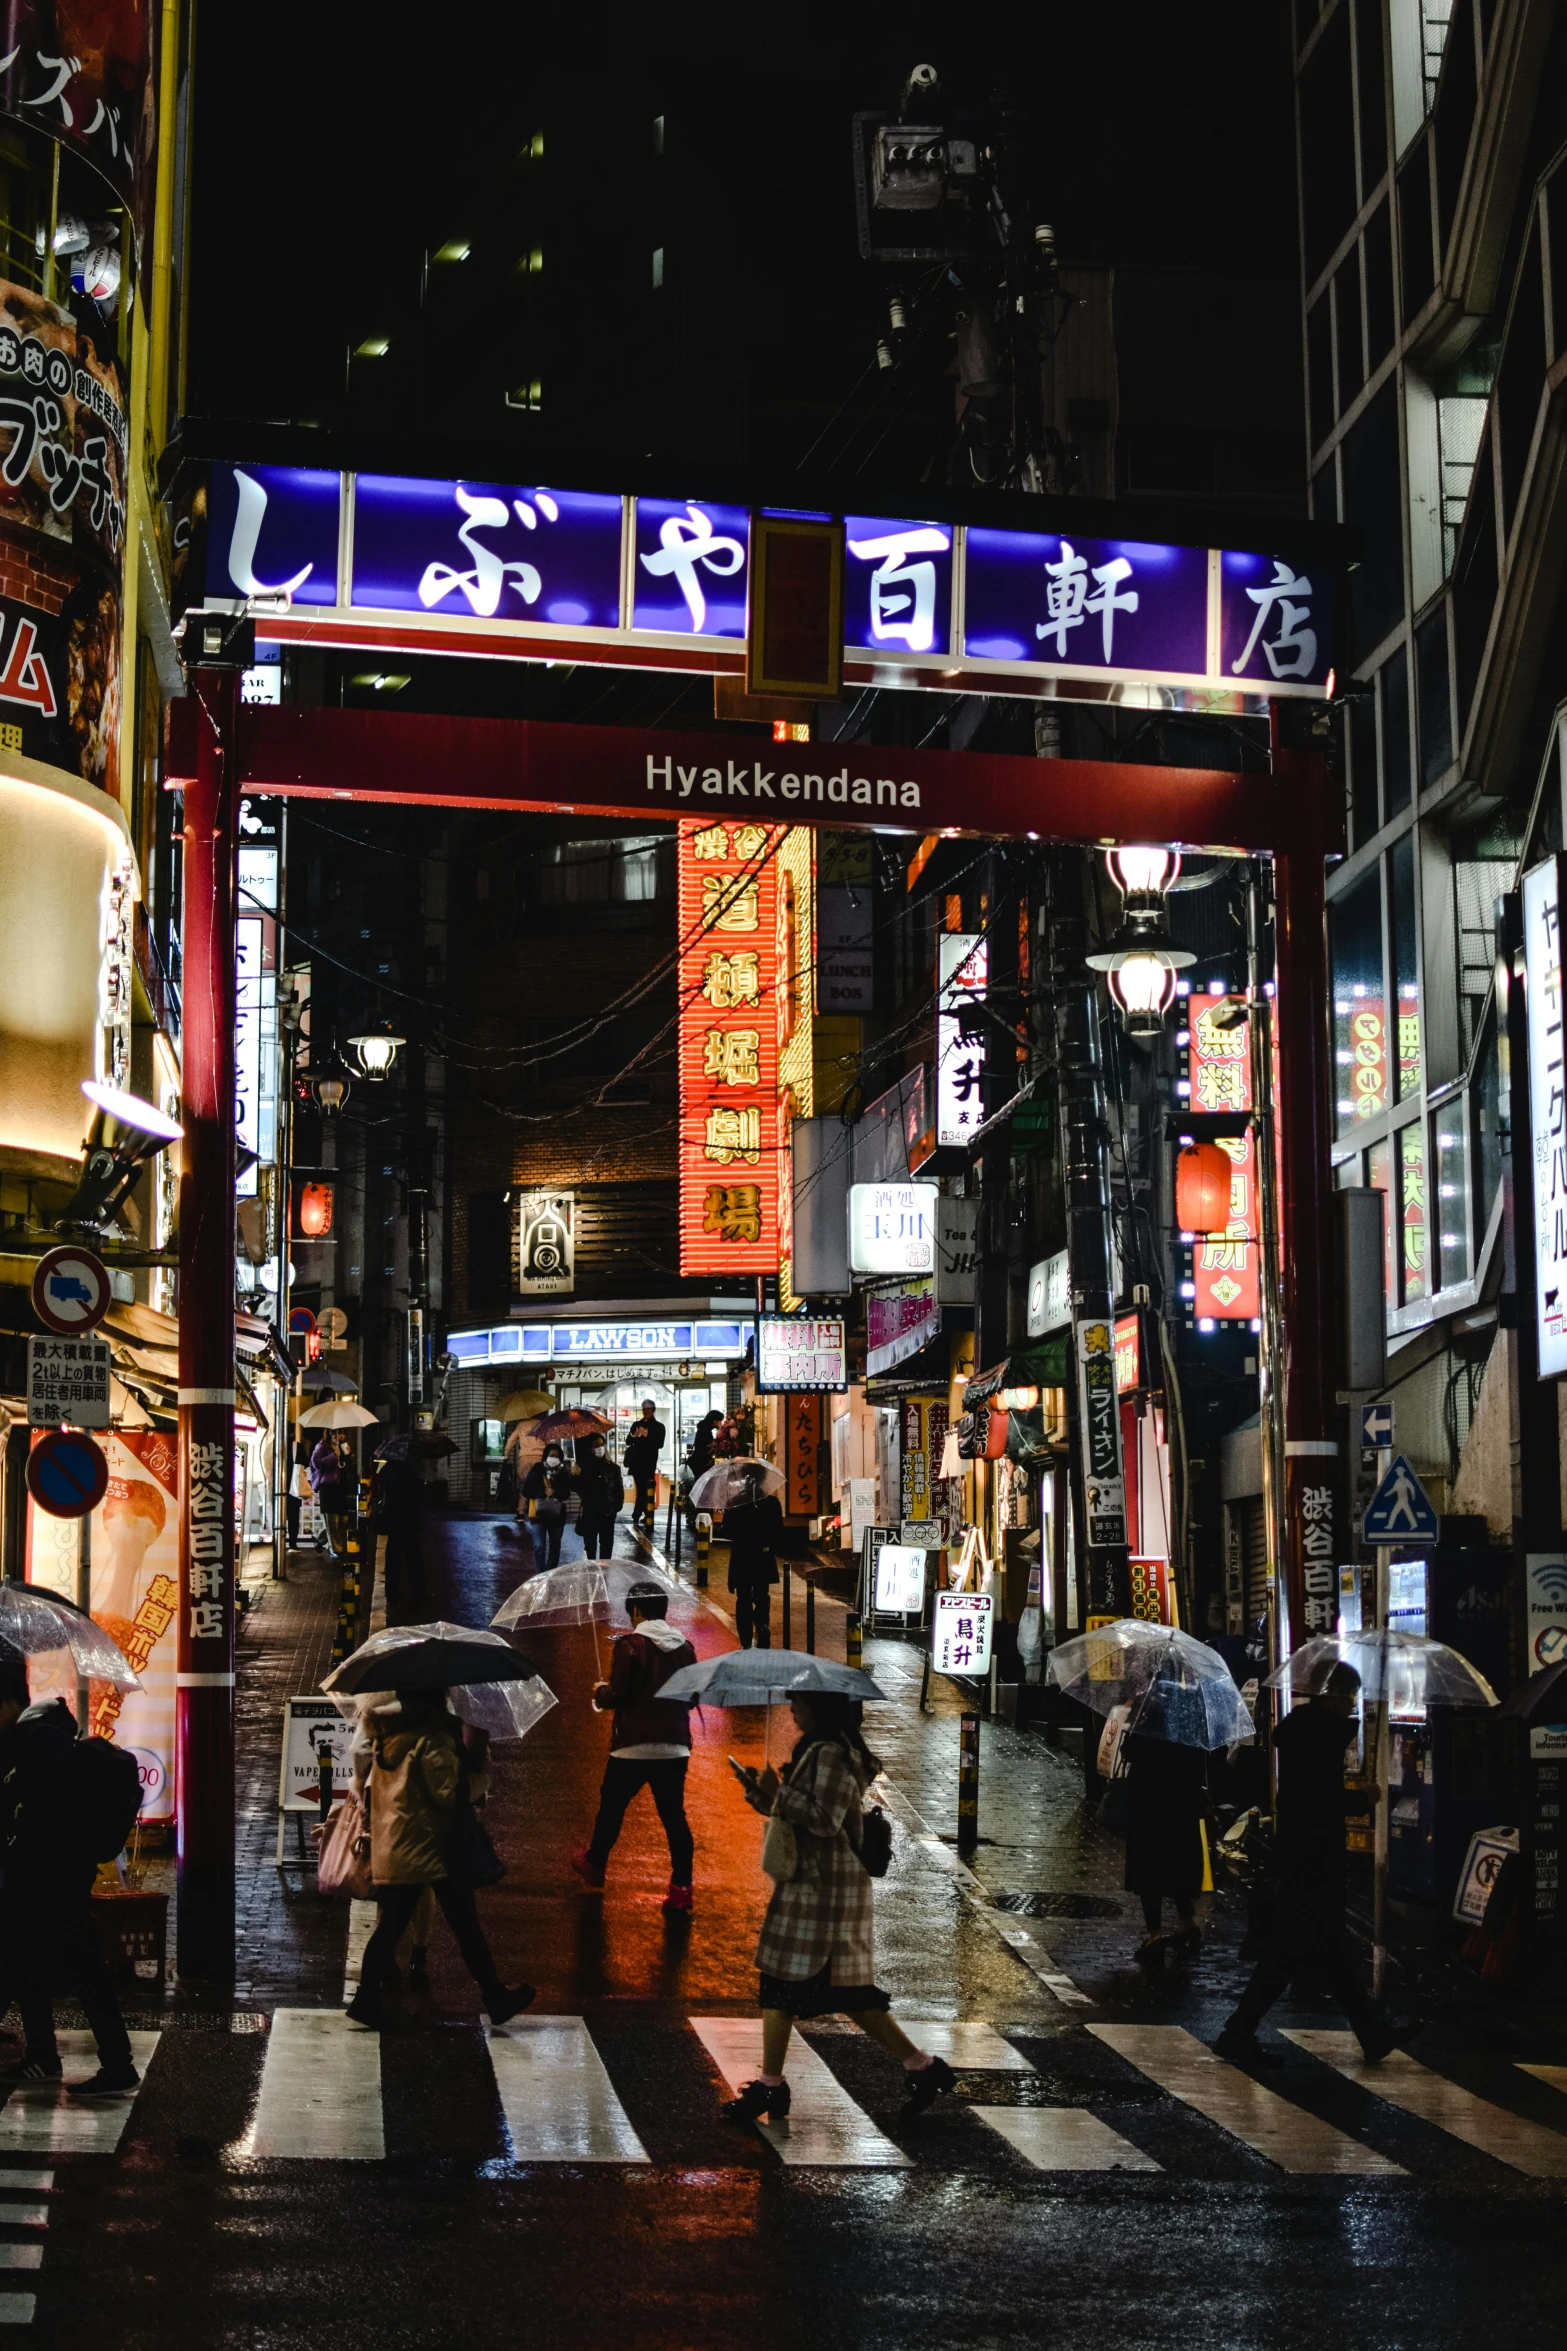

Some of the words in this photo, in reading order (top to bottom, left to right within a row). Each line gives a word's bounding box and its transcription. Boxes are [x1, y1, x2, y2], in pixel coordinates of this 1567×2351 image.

[228, 468, 745, 634] しぶや
[847, 525, 1320, 678] 百軒店
[0, 612, 58, 718] ム
[646, 754, 921, 807] Hyakkendana
[694, 824, 769, 862] 渋谷
[839, 935, 851, 943] 2F
[820, 964, 872, 977] LUNCH
[830, 986, 863, 1000] BOX
[945, 1229, 966, 1240] Tea
[569, 1326, 676, 1350] LAWSON
[763, 1322, 815, 1350] 無料
[33, 1342, 107, 1362] 最大積載量
[32, 1362, 107, 1382] 2t以上の貨物
[764, 1353, 841, 1381] 案内所
[32, 1383, 107, 1402] 居住者用車両
[32, 1404, 72, 1421] を除く
[906, 1405, 919, 1450] 入場無料
[188, 1441, 225, 1639] 渋谷百軒店
[1133, 1566, 1145, 1618] 割引価格
[1532, 1603, 1551, 1612] Free
[953, 1617, 974, 1666] 鳥升
[137, 1765, 160, 1787] 00
[294, 1766, 320, 1778] VAPE
